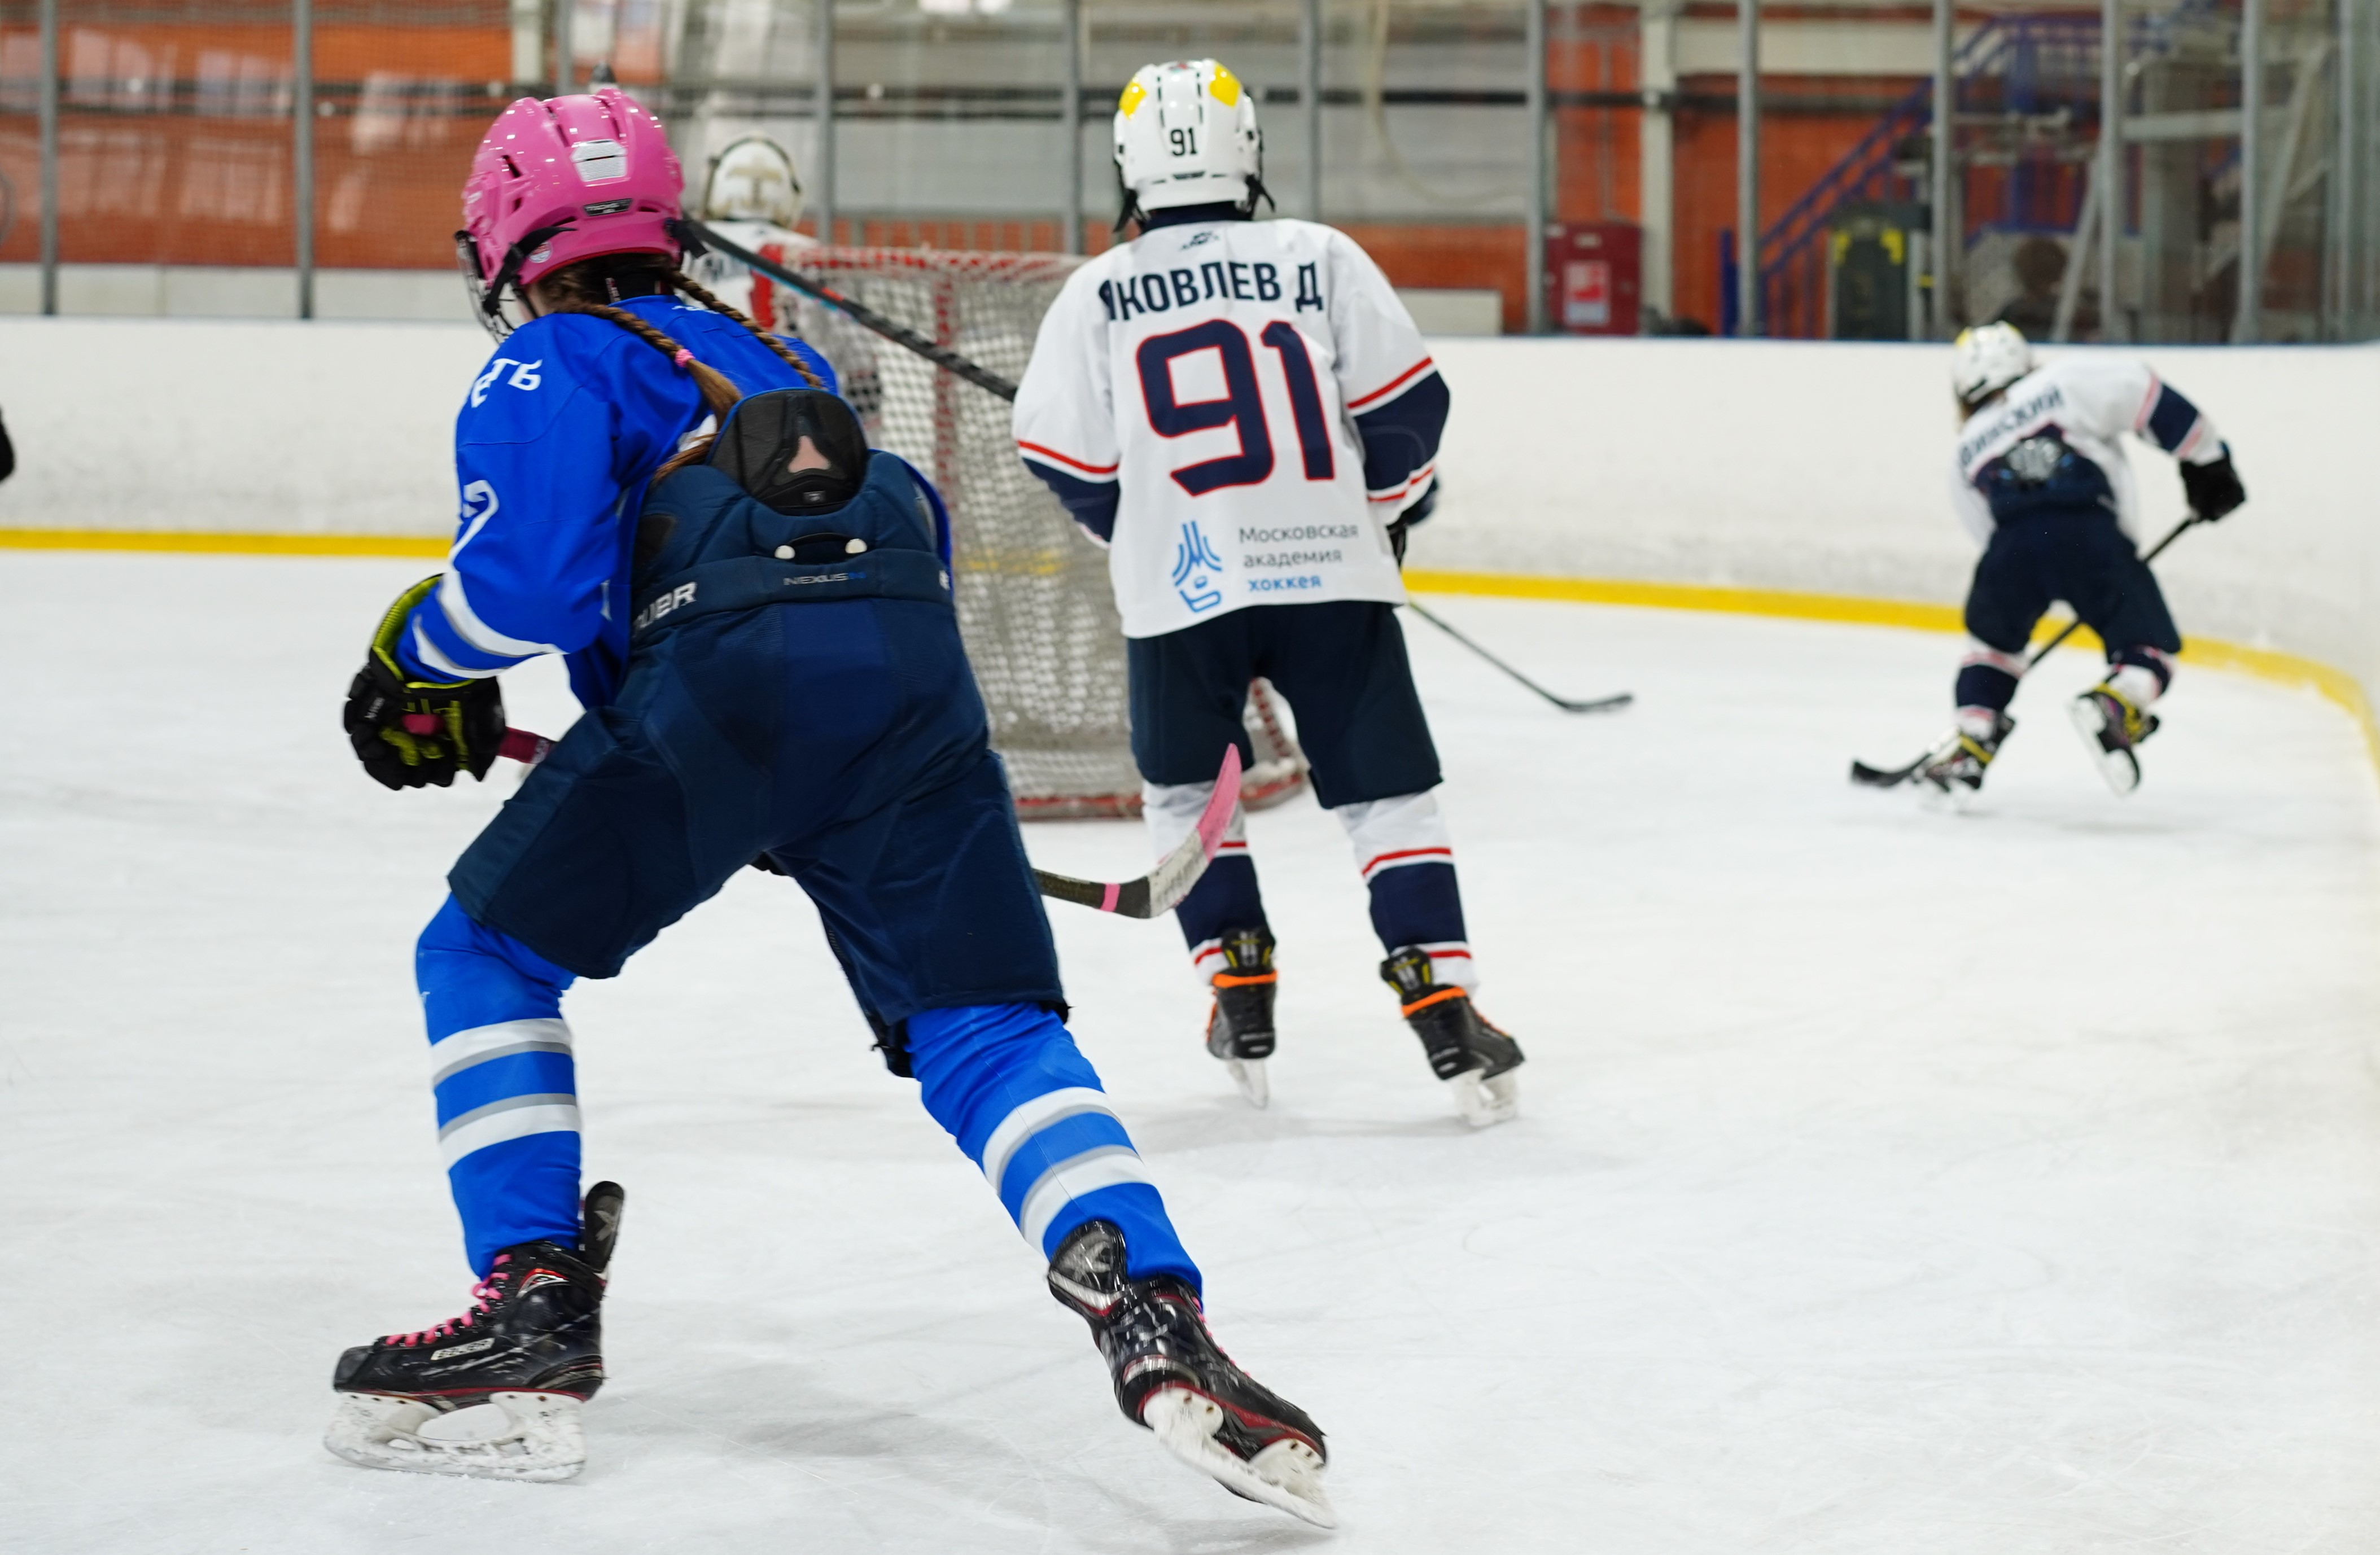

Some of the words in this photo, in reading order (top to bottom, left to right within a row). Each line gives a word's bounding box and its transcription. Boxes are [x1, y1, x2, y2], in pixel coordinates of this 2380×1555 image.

[1170, 127, 1198, 156] 91
[1294, 261, 1323, 312] Д
[1136, 319, 1336, 498] 91
[1240, 525, 1359, 544] Московская
[1244, 550, 1343, 568] академия
[1248, 575, 1322, 592] хоккея
